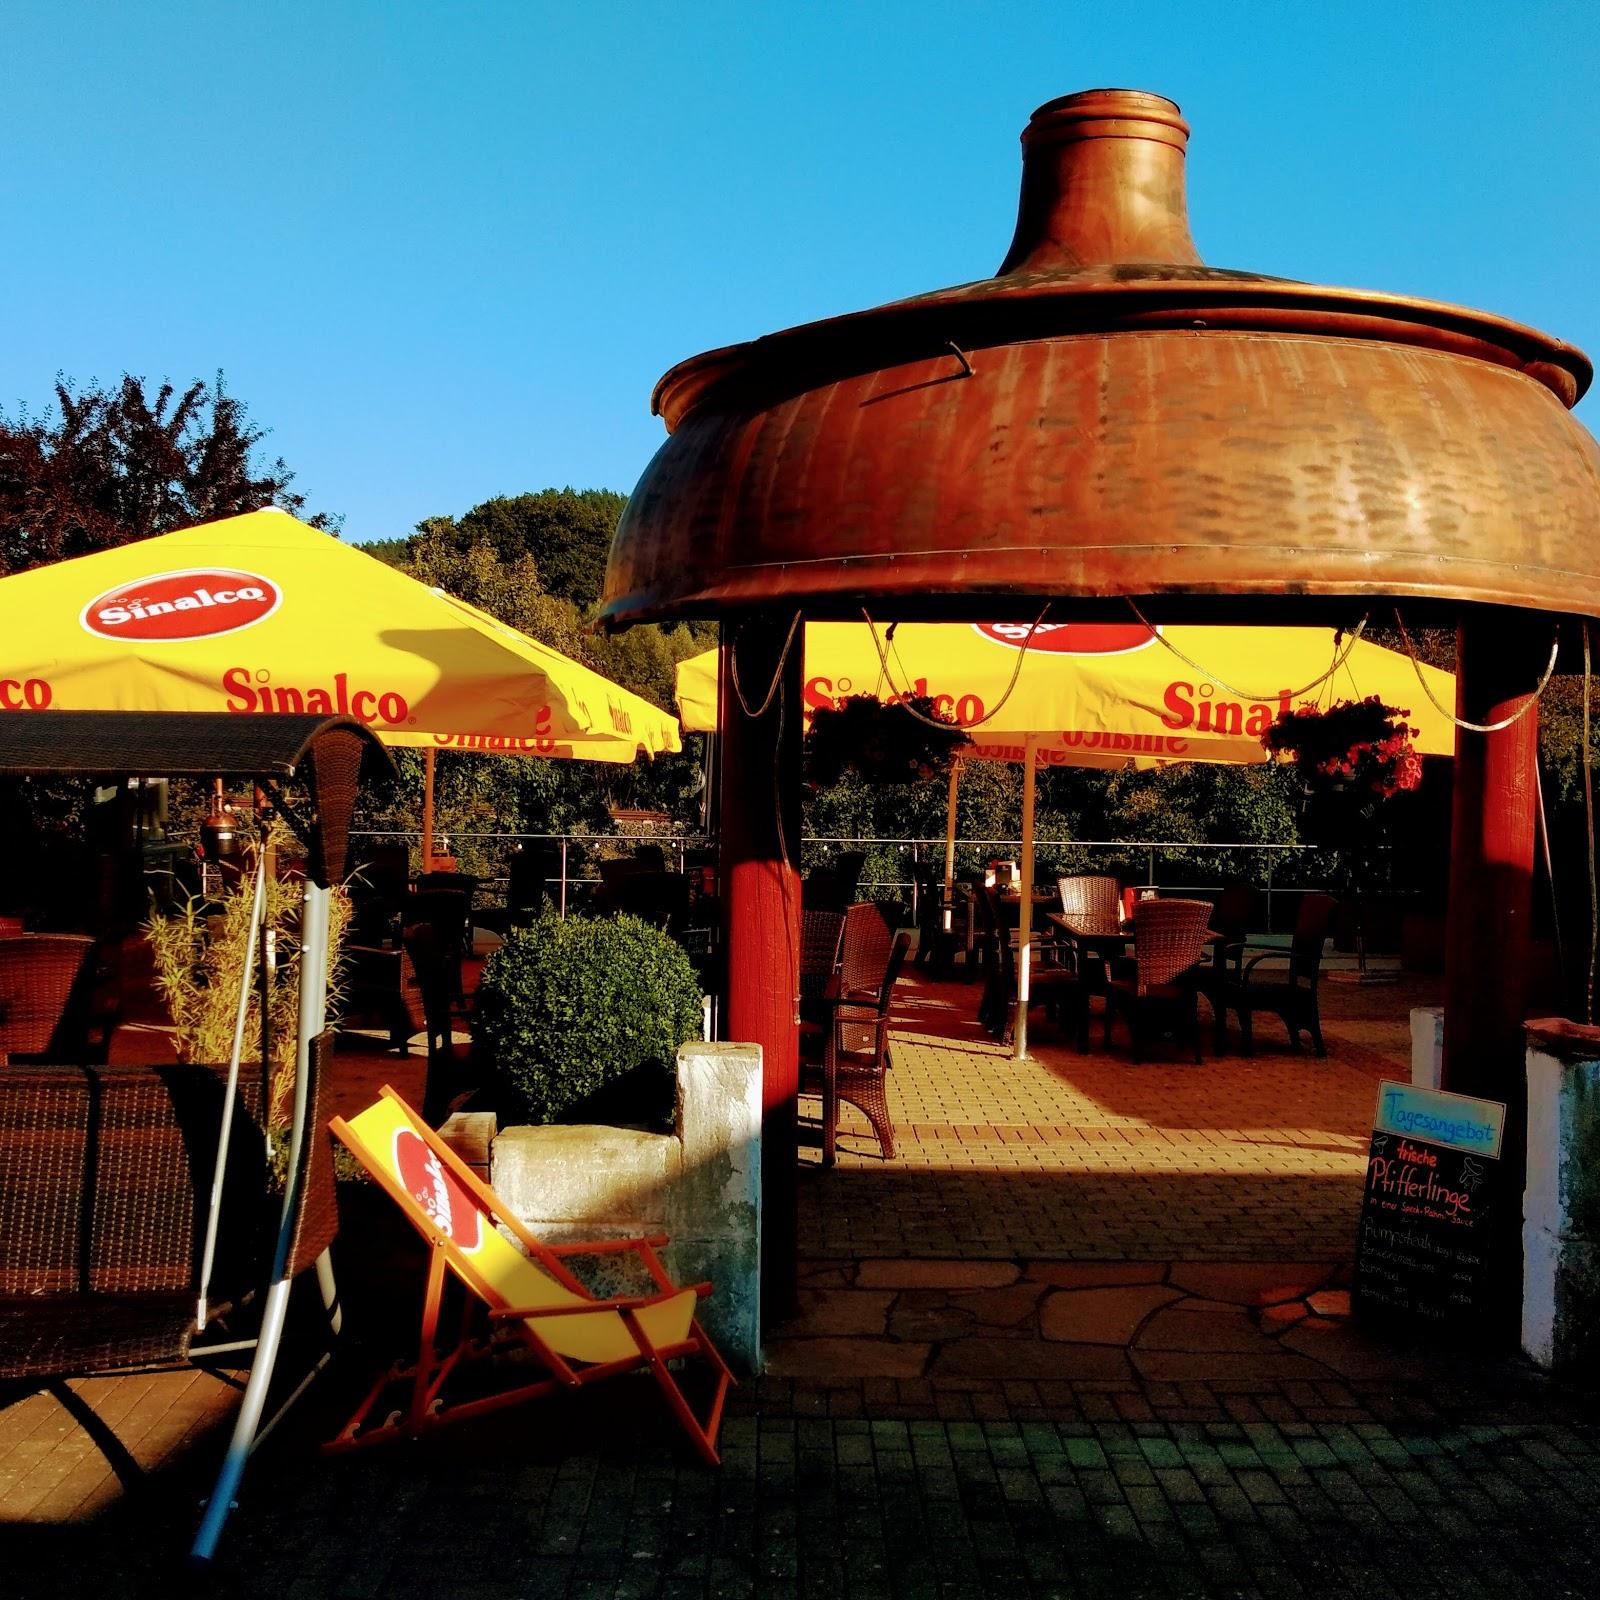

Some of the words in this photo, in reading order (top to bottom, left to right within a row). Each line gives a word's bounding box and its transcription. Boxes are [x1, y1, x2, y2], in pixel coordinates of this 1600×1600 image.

[98, 586, 264, 625] Sinalco
[222, 667, 409, 724] Sinalco
[1385, 1092, 1497, 1144] Tagesangebot
[1397, 1140, 1438, 1167] frische
[1369, 1156, 1471, 1216] Pfifferlinge
